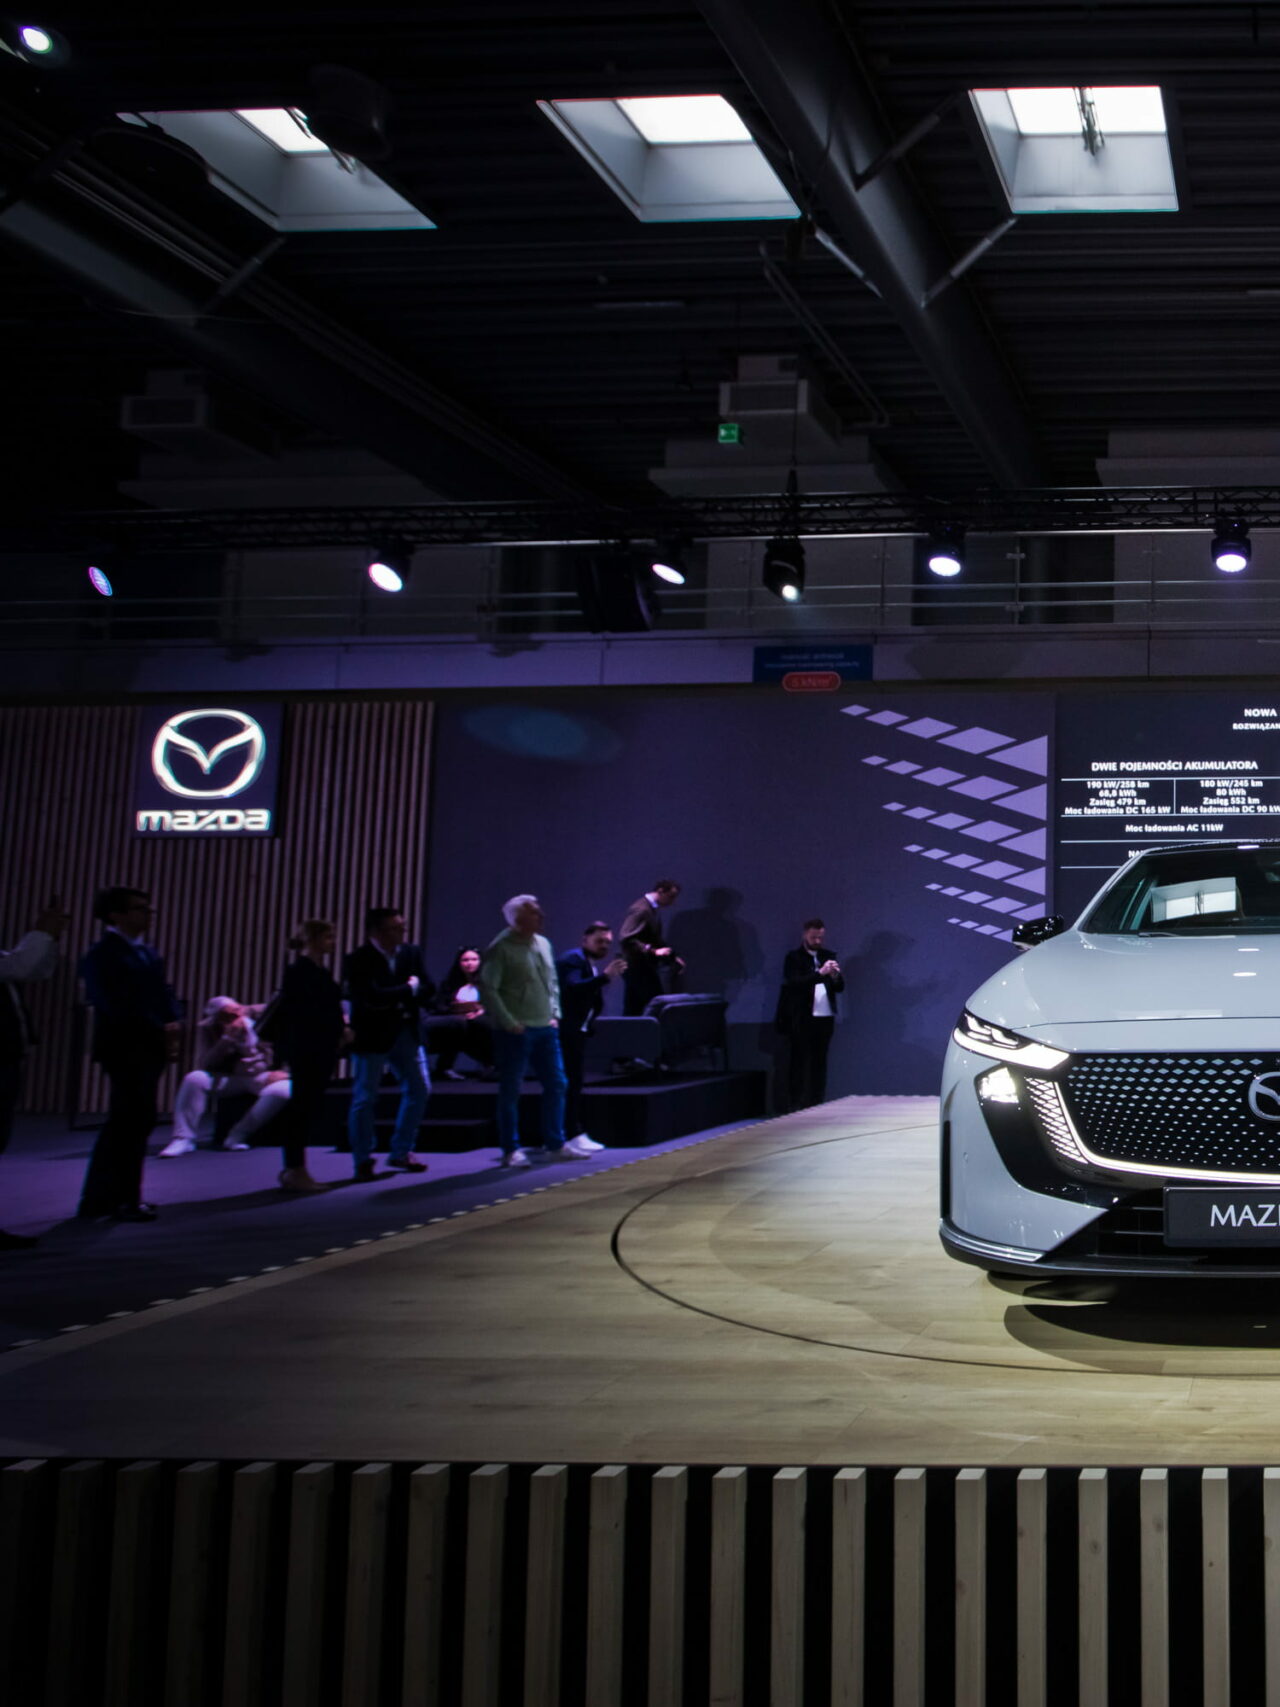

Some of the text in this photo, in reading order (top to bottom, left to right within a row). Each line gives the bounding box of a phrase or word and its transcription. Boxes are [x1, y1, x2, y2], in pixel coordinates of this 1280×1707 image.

[1244, 708, 1277, 717] NOWA
[1091, 760, 1259, 772] DWIE POJEMNOŚCI AKUMULATORA
[1087, 781, 1102, 789] 190
[1200, 780, 1215, 788] 180
[1119, 789, 1137, 797] kWh
[1216, 788, 1247, 796] 80 kWh
[1089, 798, 1147, 807] Zasięg 479 km
[1202, 796, 1260, 806] Zasięg 552 km
[1064, 807, 1082, 815] Moc
[1125, 806, 1139, 814] DC
[1141, 806, 1156, 814] 165
[1157, 806, 1171, 814] kW
[1180, 805, 1198, 814] Moc
[1241, 805, 1255, 813] DC
[1256, 805, 1268, 813] 90
[136, 808, 271, 832] mazda
[1125, 824, 1143, 833] Moc
[1186, 823, 1199, 832] AC
[1201, 823, 1224, 832] 11kW
